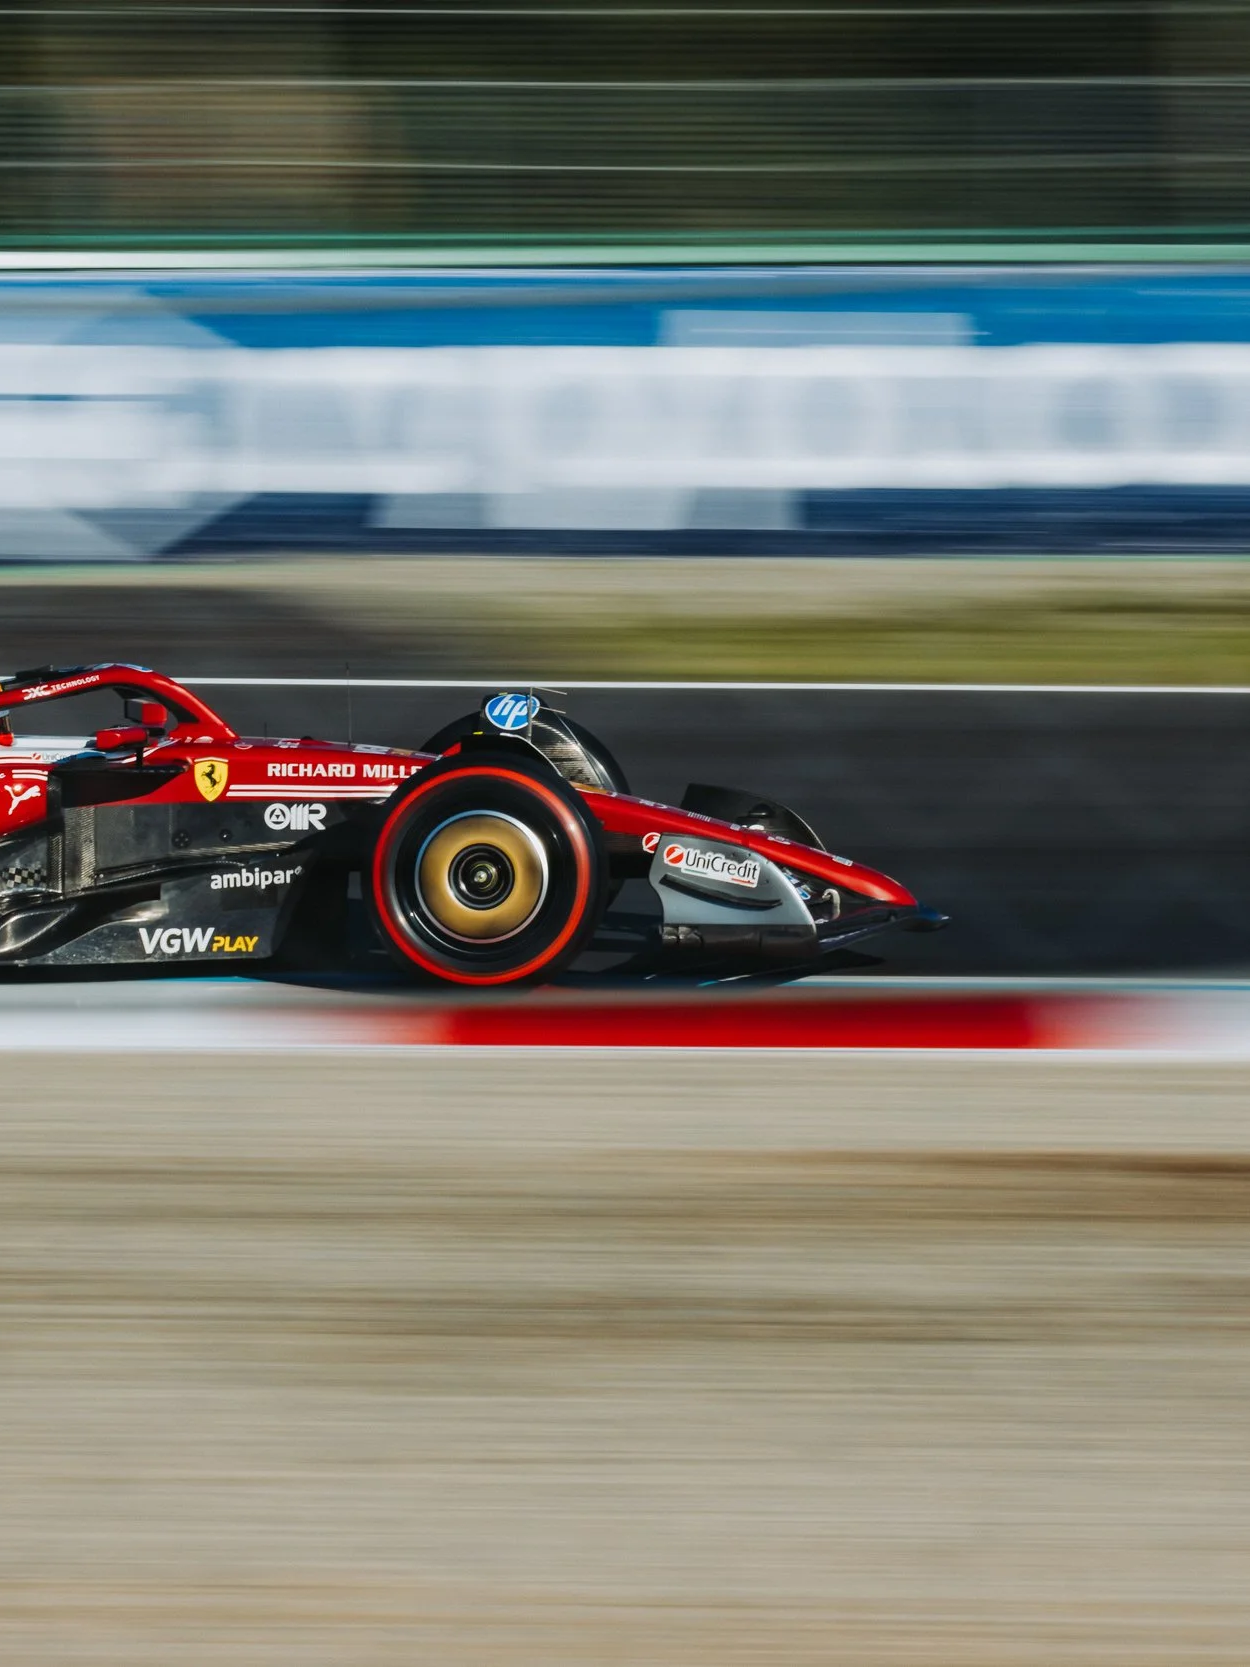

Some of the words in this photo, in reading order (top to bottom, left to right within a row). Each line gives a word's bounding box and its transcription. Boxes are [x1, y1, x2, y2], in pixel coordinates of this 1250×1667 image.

[51, 675, 100, 692] TECHNOLOGY
[267, 763, 356, 778] RICHARD
[686, 849, 758, 880] UniCredit
[210, 867, 294, 889] ambipar
[139, 927, 215, 954] VGW
[212, 936, 259, 952] PLAY
